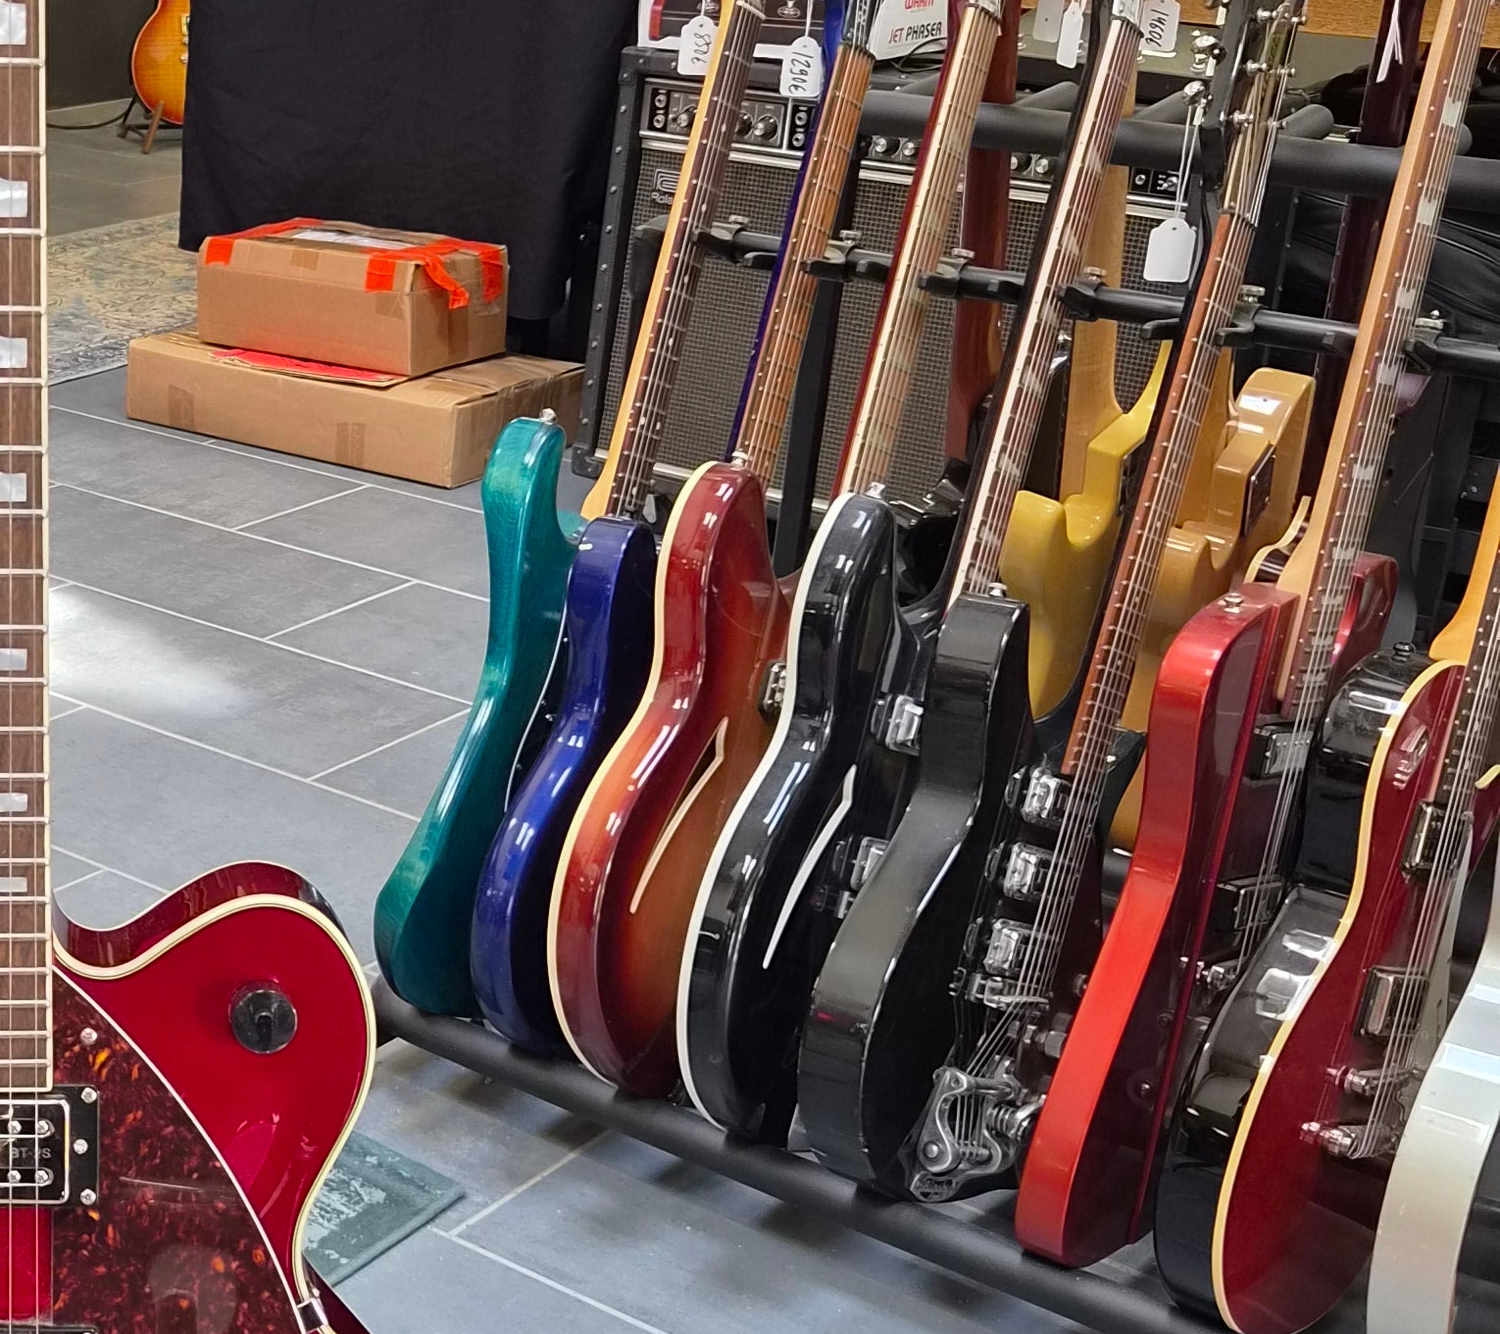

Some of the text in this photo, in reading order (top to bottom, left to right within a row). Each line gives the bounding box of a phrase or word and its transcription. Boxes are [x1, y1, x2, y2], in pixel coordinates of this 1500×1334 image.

[888, 21, 942, 44] JET PHASER
[652, 192, 673, 205] Rola
